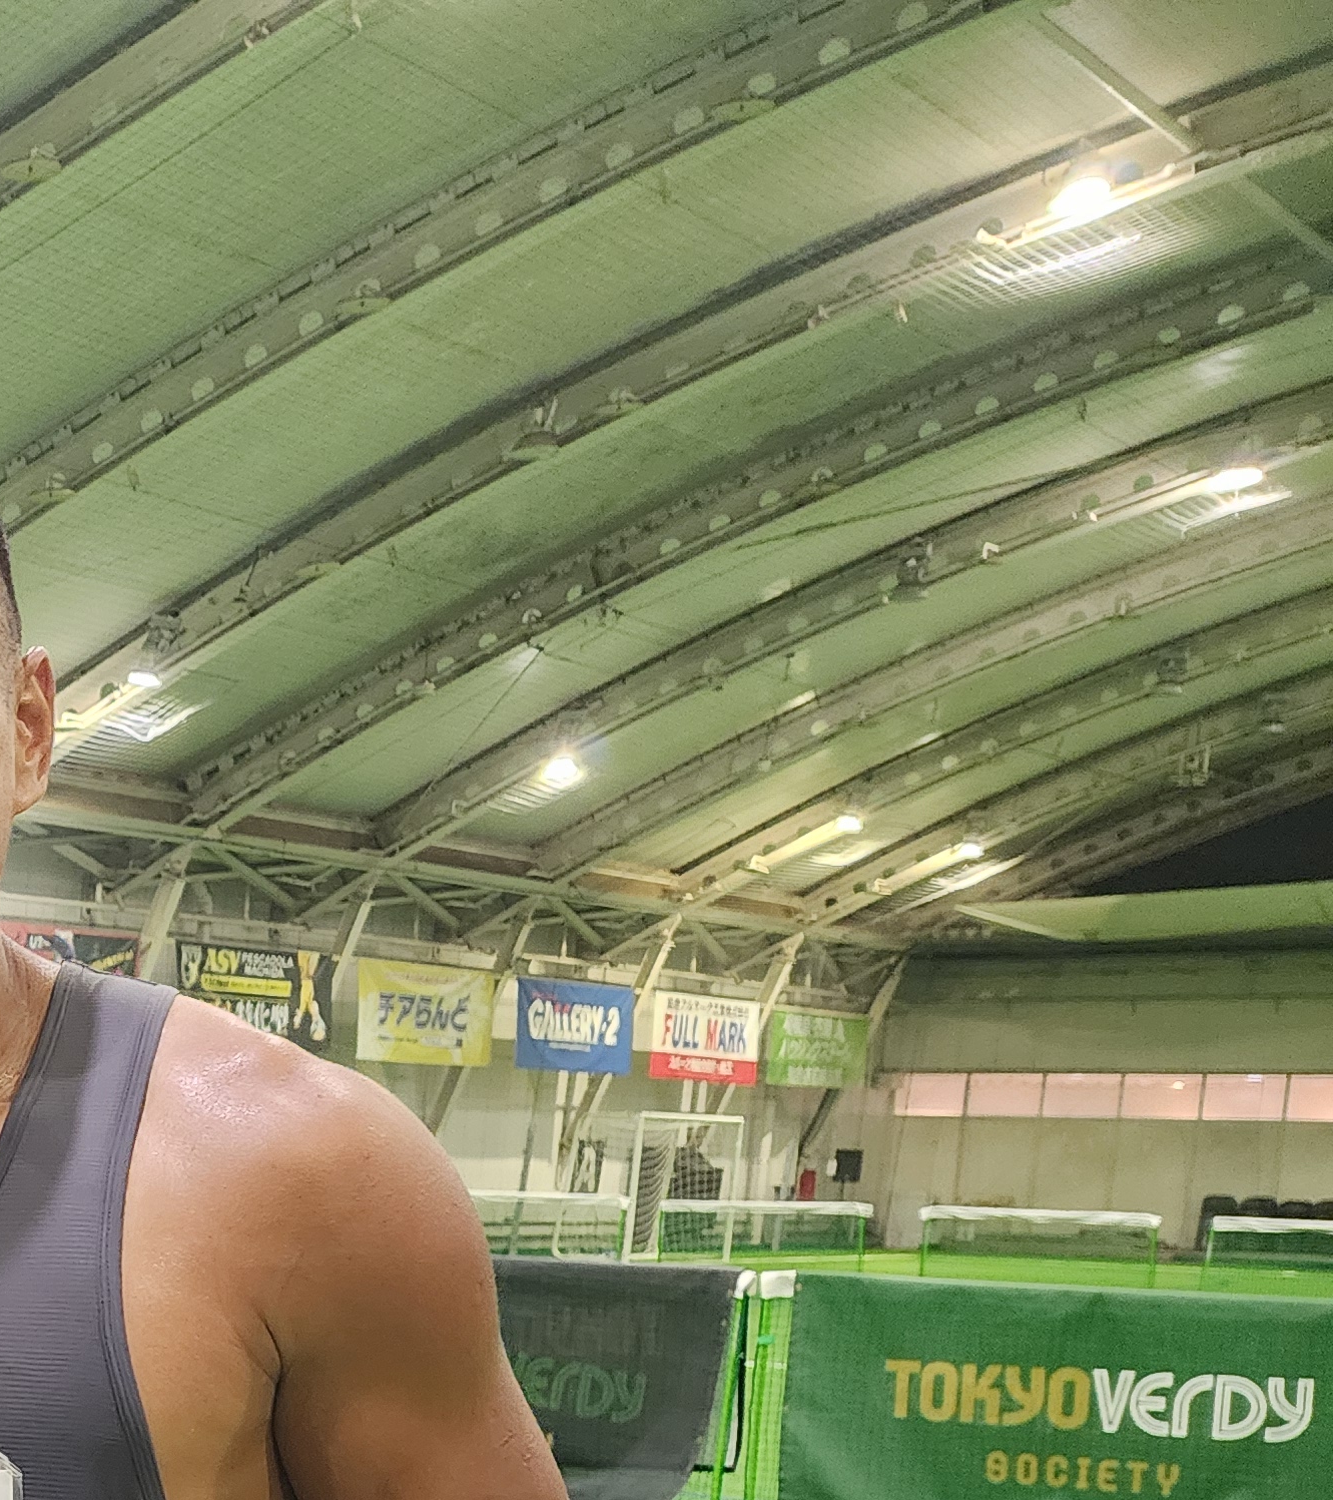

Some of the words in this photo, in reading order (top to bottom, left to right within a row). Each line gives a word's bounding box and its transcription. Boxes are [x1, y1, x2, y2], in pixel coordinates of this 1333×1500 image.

[377, 991, 471, 1033] チアらんど
[661, 1013, 700, 1049] FULL
[704, 1017, 747, 1054] MARK
[985, 1449, 1181, 1498] SOCIETY
